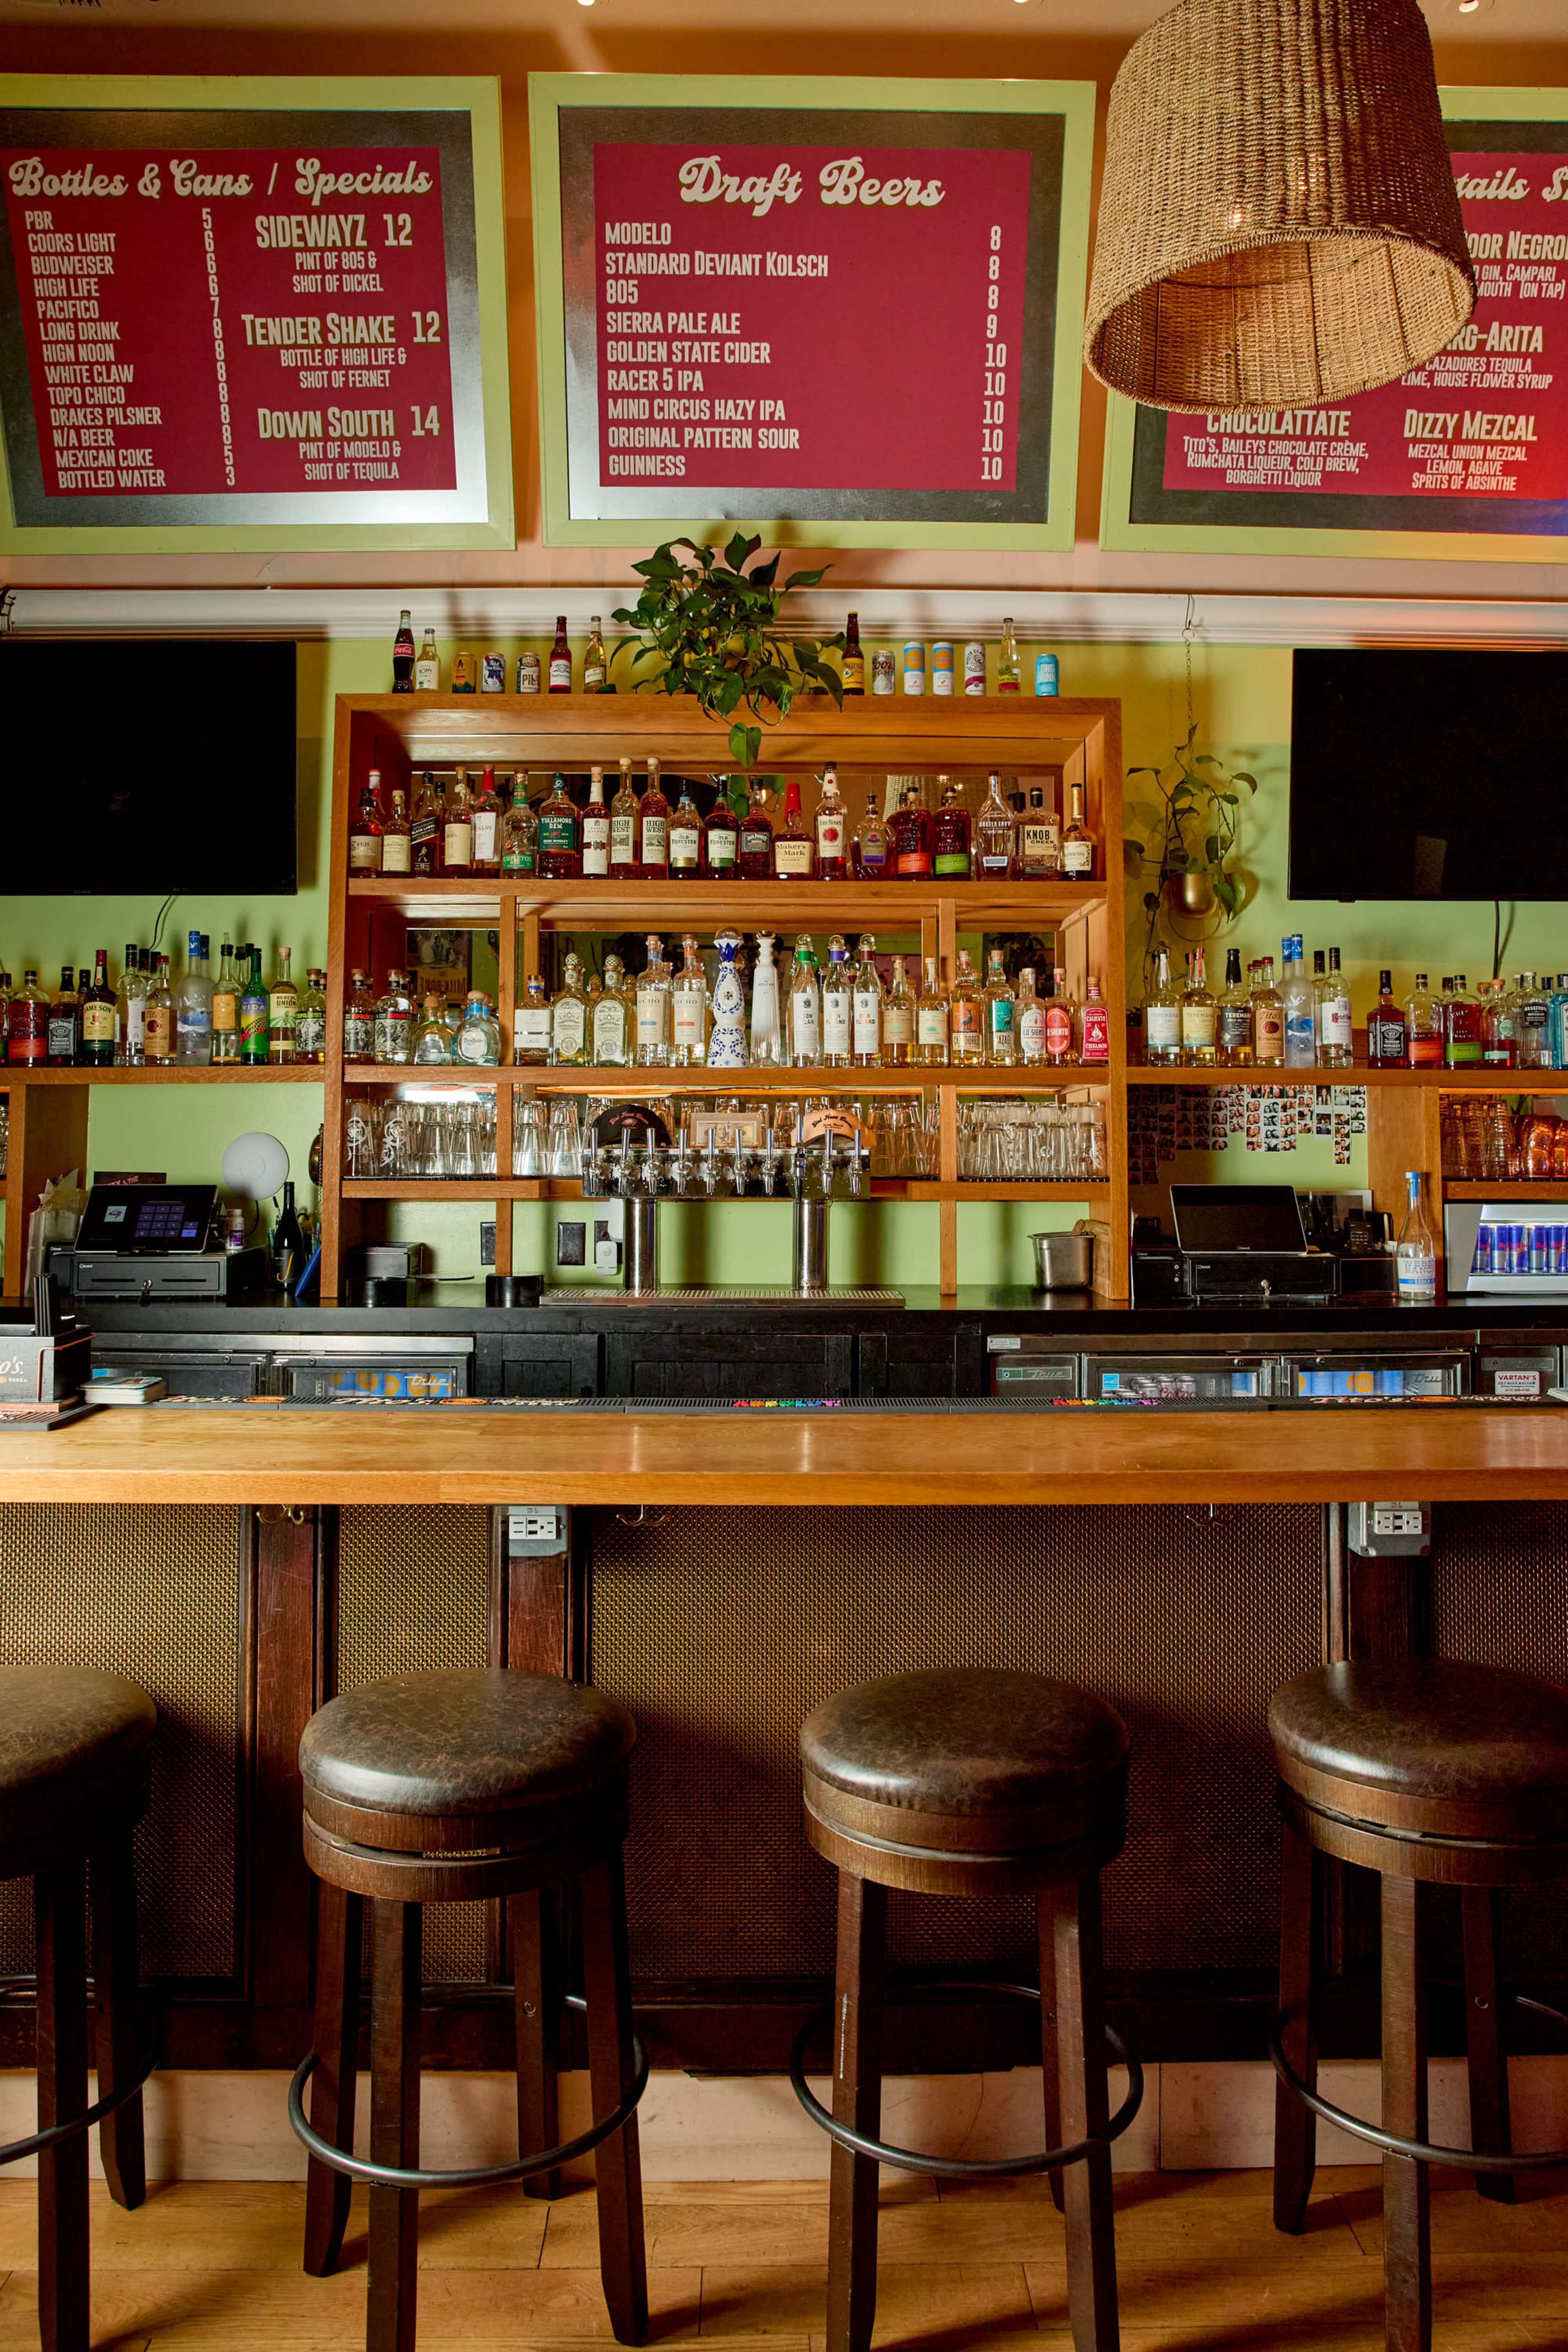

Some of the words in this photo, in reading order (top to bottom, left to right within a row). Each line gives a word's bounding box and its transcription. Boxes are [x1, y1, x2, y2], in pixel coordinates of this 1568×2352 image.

[9, 156, 129, 196] Bottles
[138, 163, 161, 199] &
[169, 159, 254, 196] Cans
[267, 163, 278, 195] /
[295, 158, 433, 206] Specials
[679, 155, 803, 217] Draft
[819, 156, 946, 207] Beers
[1455, 167, 1530, 200] tails
[24, 211, 54, 230] PBR
[255, 214, 367, 248] SIDEWAYZ
[383, 213, 412, 246] 12
[28, 233, 74, 252] COORS
[77, 233, 116, 252] LIGHT
[605, 222, 671, 245] MODELO
[1464, 230, 1503, 259] OOR
[1506, 231, 1568, 261] NEGRO
[31, 256, 115, 275] BUDWEISER
[295, 252, 321, 270] PINT
[324, 252, 339, 270] OF
[341, 251, 365, 270] 805
[368, 251, 377, 269] &
[606, 252, 690, 275] STANDARD
[695, 250, 762, 276] DEVIANT
[766, 252, 828, 277] KOLSCH
[293, 275, 322, 293] SHOT
[325, 274, 339, 292] OF
[342, 274, 384, 292] DICKEL
[1481, 264, 1503, 285] GIN,
[1506, 263, 1557, 282] CAMPARI
[34, 278, 67, 297] HIGH
[69, 278, 100, 297] LIFE
[606, 279, 638, 304] 805
[1477, 282, 1512, 297] MOUTH
[1519, 280, 1539, 299] (ON
[1541, 279, 1566, 300] TAP)
[36, 300, 99, 319] PACIFICO
[40, 322, 76, 341] LONG
[78, 322, 120, 340] DRINK
[241, 314, 323, 345] TENDER
[326, 312, 396, 344] SHAKE
[412, 311, 441, 343] 12
[606, 312, 664, 333] SIERRA
[668, 312, 707, 334] PALE
[710, 313, 740, 334] ALE
[1446, 321, 1543, 353] RG-ARITA
[42, 344, 75, 362] HIGN
[78, 343, 115, 362] NOON
[280, 349, 322, 367] BOTTLE
[324, 348, 339, 366] OF
[341, 348, 368, 365] HIGH
[371, 347, 396, 365] LIFE
[398, 347, 407, 365] &
[607, 341, 667, 362] GOLDEN
[672, 341, 720, 363] STATE
[724, 342, 771, 363] CIDER
[44, 365, 91, 384] WHITE
[93, 365, 134, 383] CLAW
[1489, 357, 1532, 374] TEQUILA
[299, 371, 329, 388] SHOT
[331, 370, 345, 388] OF
[348, 370, 390, 387] FERNET
[608, 370, 659, 391] RACER
[663, 368, 673, 391] 5
[678, 370, 704, 391] IPA
[1433, 372, 1469, 387] HOUSE
[1470, 372, 1515, 389] FLOWER
[1517, 374, 1553, 389] SYRUP
[47, 386, 82, 405] TOPO
[85, 386, 125, 405] CHICO
[50, 408, 103, 426] DRAKES
[106, 407, 162, 425] PILSNER
[608, 399, 649, 419] MIND
[653, 399, 710, 420] CIRCUS
[715, 399, 755, 420] HAZY
[760, 400, 786, 421] IPA
[258, 408, 323, 439] DOWN
[327, 407, 394, 437] SOUTH
[411, 405, 440, 436] 14
[1206, 410, 1351, 436] CHOCOLATTATE
[1403, 409, 1459, 439] DIZZY
[1461, 410, 1537, 441] MEZCAL
[53, 427, 79, 447] N/A
[80, 428, 115, 447] BEER
[608, 427, 680, 448] ORIGINAL
[684, 428, 752, 448] PATTERN
[758, 428, 800, 449] SOUR
[299, 442, 324, 459] PINT
[327, 441, 341, 459] OF
[343, 441, 390, 458] MODELO
[392, 440, 401, 457] &
[1183, 436, 1218, 457] TITO'S,
[1222, 437, 1266, 454] BAILEYS
[1268, 440, 1328, 456] CHOCOLATE
[1330, 440, 1369, 459] CRÈME,
[1408, 443, 1450, 459] MEZCAL
[1452, 445, 1484, 459] UNION
[1486, 445, 1527, 461] MEZCAL
[55, 449, 116, 468] MEXICAN
[118, 449, 154, 467] COKE
[609, 455, 686, 476] GUINNESS
[1187, 452, 1245, 469] RUMCHATA
[1247, 454, 1294, 472] LIQUEUR,
[1296, 456, 1323, 471] COLD
[1325, 457, 1359, 474] BREW,
[1426, 459, 1466, 478] LEMON,
[1468, 461, 1503, 475] AGAVE
[58, 470, 115, 488] BOTTLED
[117, 469, 166, 487] WATER
[305, 463, 333, 480] SHOT
[336, 463, 350, 480] OF
[352, 462, 399, 481] TEQUILA
[1226, 467, 1282, 485] BORGHETTI
[1283, 468, 1321, 488] LIQUOR
[1412, 472, 1449, 489] SPRITS
[1450, 474, 1465, 490] OF
[1466, 475, 1517, 491] ABSINTHE
[1037, 664, 1055, 673] LONG
[1027, 830, 1050, 840] KNOB
[84, 1004, 112, 1013] JAMESON
